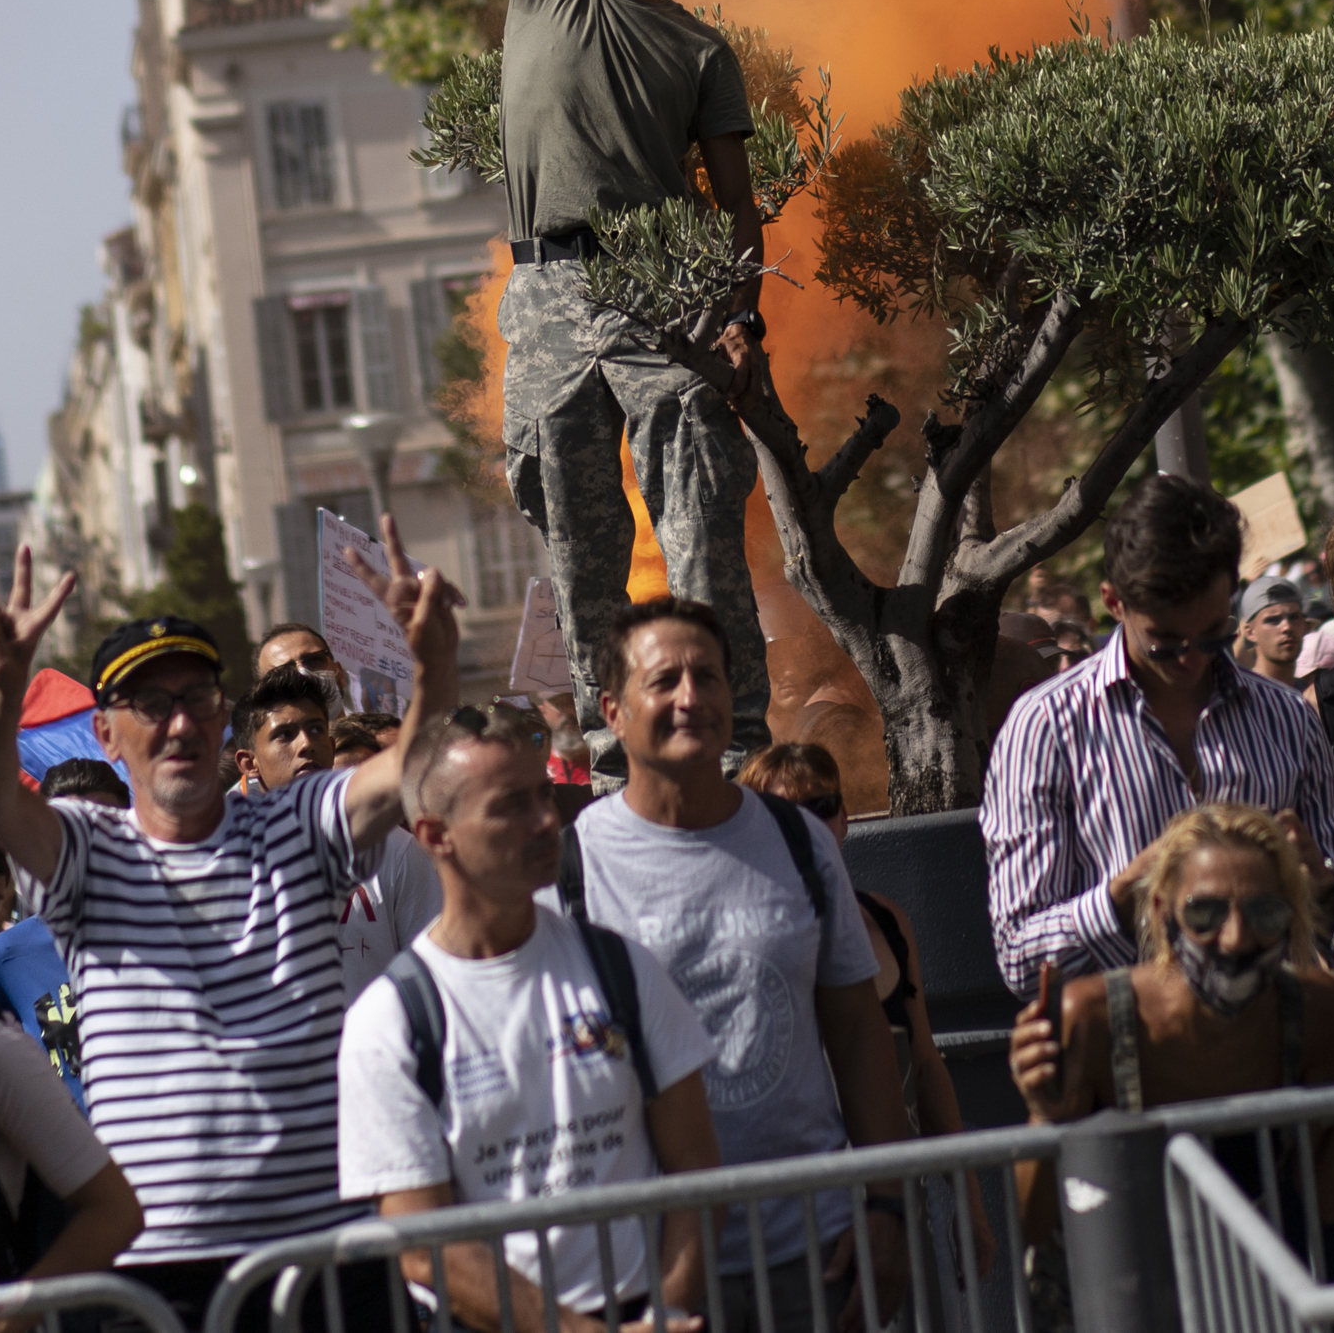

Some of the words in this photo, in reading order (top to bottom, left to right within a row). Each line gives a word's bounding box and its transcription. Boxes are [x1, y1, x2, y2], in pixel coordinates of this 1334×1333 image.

[474, 1144, 498, 1164] Je
[582, 1105, 626, 1135] pour
[602, 1130, 625, 1151] de
